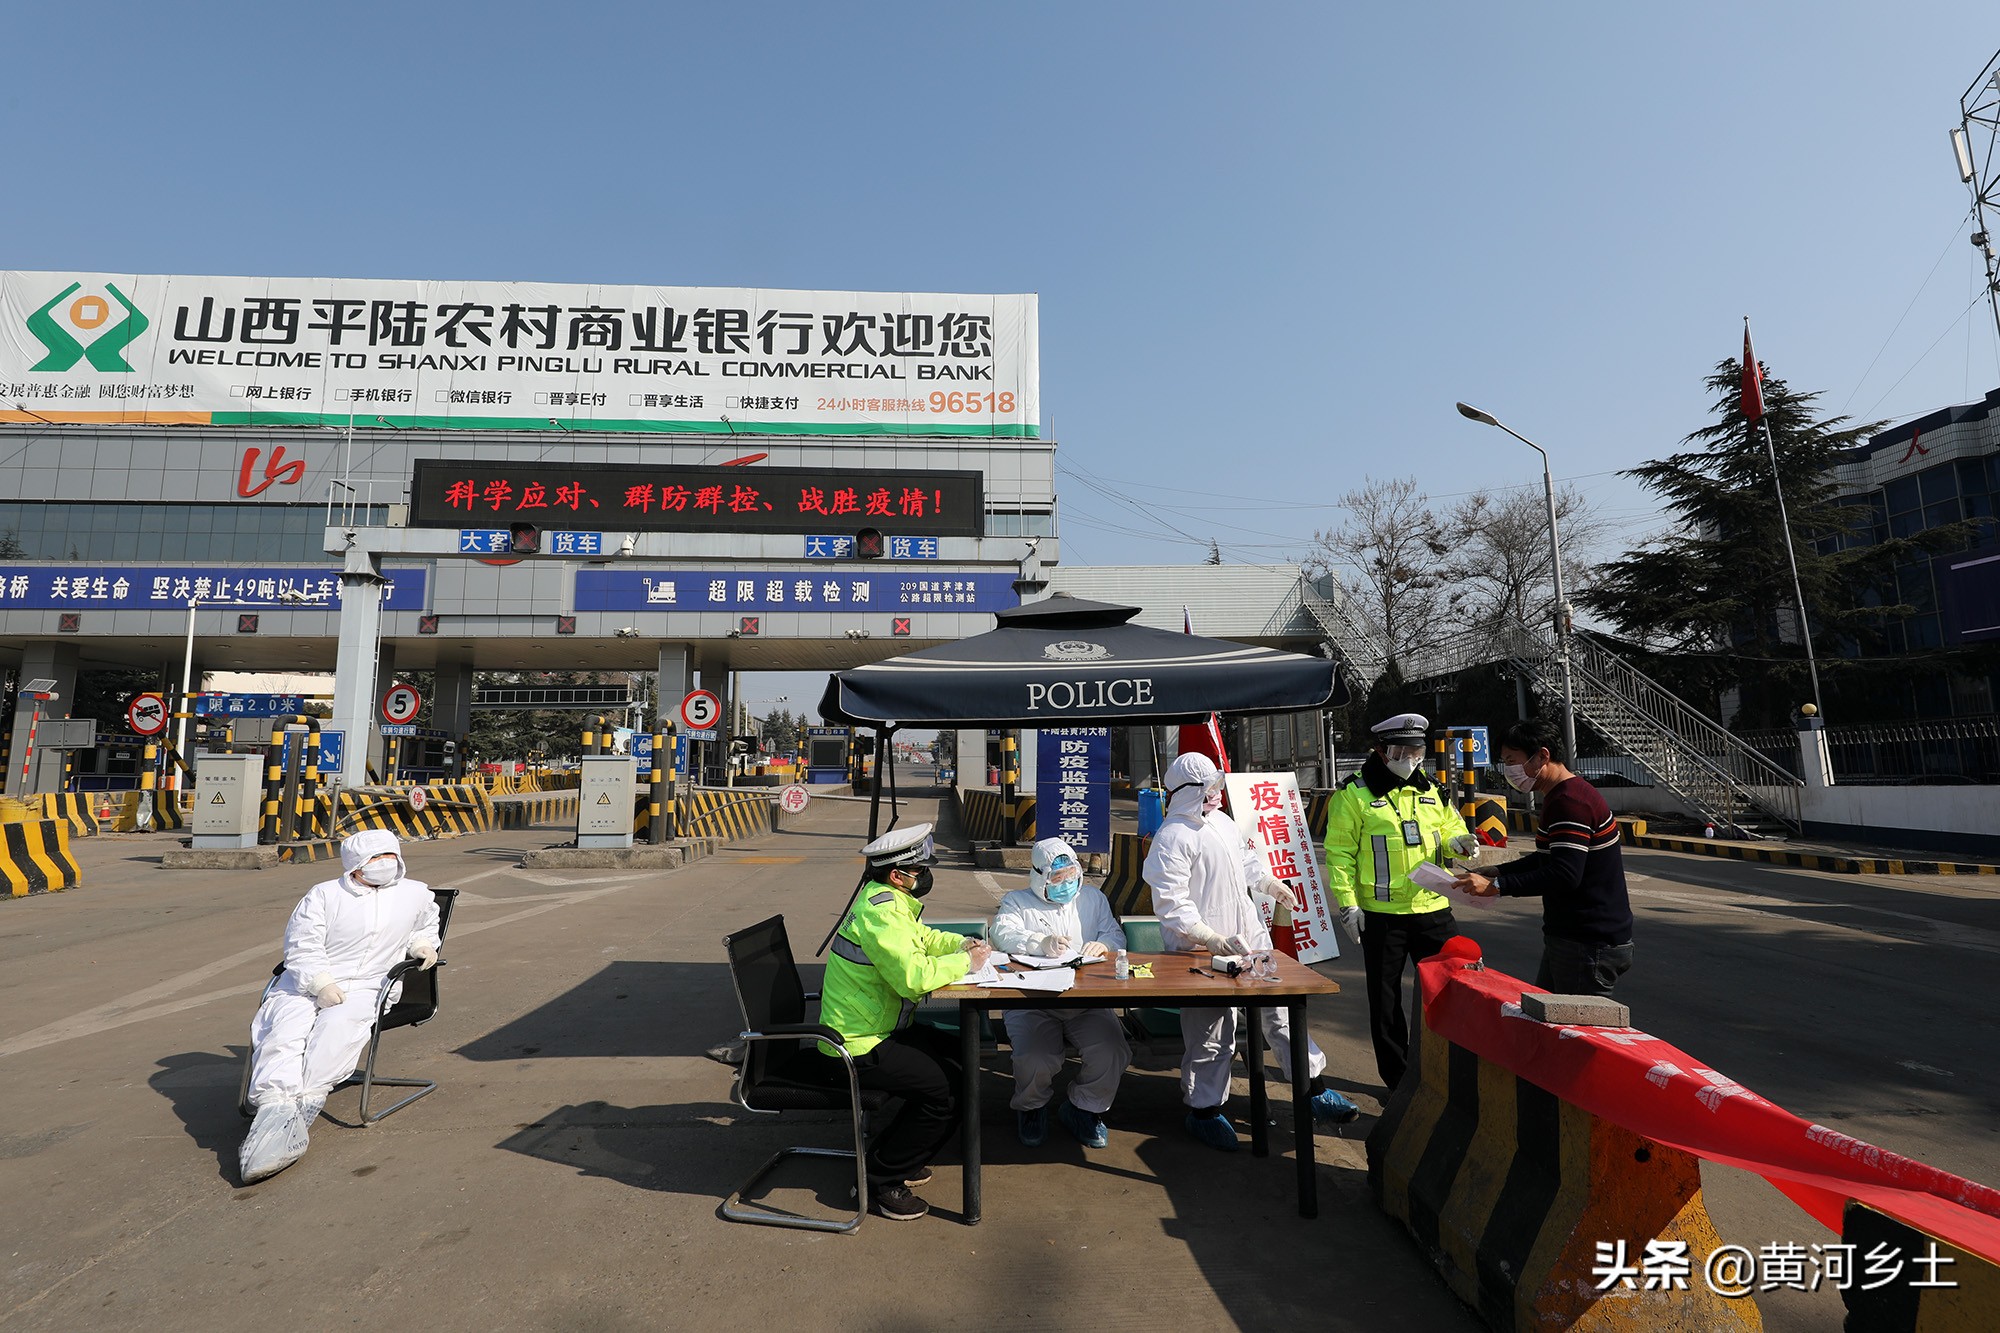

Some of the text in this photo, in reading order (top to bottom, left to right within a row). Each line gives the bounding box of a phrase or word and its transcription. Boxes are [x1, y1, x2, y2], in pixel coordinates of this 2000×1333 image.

[174, 297, 991, 358] 山西平陆农村商业银行欢迎您
[169, 350, 992, 381] WELCOME TO SHANXI PINGLU RURAL COMMERCIAL BANK
[99, 383, 195, 399] 圆您财富梦想
[246, 386, 311, 401] 网上银行
[350, 388, 412, 403] 手机银行
[450, 390, 512, 405] 微信银行
[549, 391, 607, 406] 晋享E付
[643, 393, 704, 409] 晋享生活
[740, 395, 800, 410] 快捷支付
[817, 391, 1015, 414] 24小时客服热线 96518
[462, 531, 509, 552] 大客
[555, 533, 598, 554] 货车
[808, 537, 851, 558] 大客
[893, 538, 936, 558] 货车
[50, 576, 131, 600] 关爱生命
[708, 580, 870, 603] 超限超载检测
[900, 581, 975, 592] 209国道茅津渡
[900, 593, 976, 603] 公路超限检测站
[393, 693, 407, 715] 5
[1027, 679, 1155, 710] POLICE
[694, 699, 708, 720] 5
[786, 790, 804, 809] 停
[1059, 739, 1090, 847] 防疫监督检查站
[1287, 789, 1329, 932] 新型冠状病毒感染的肺炎
